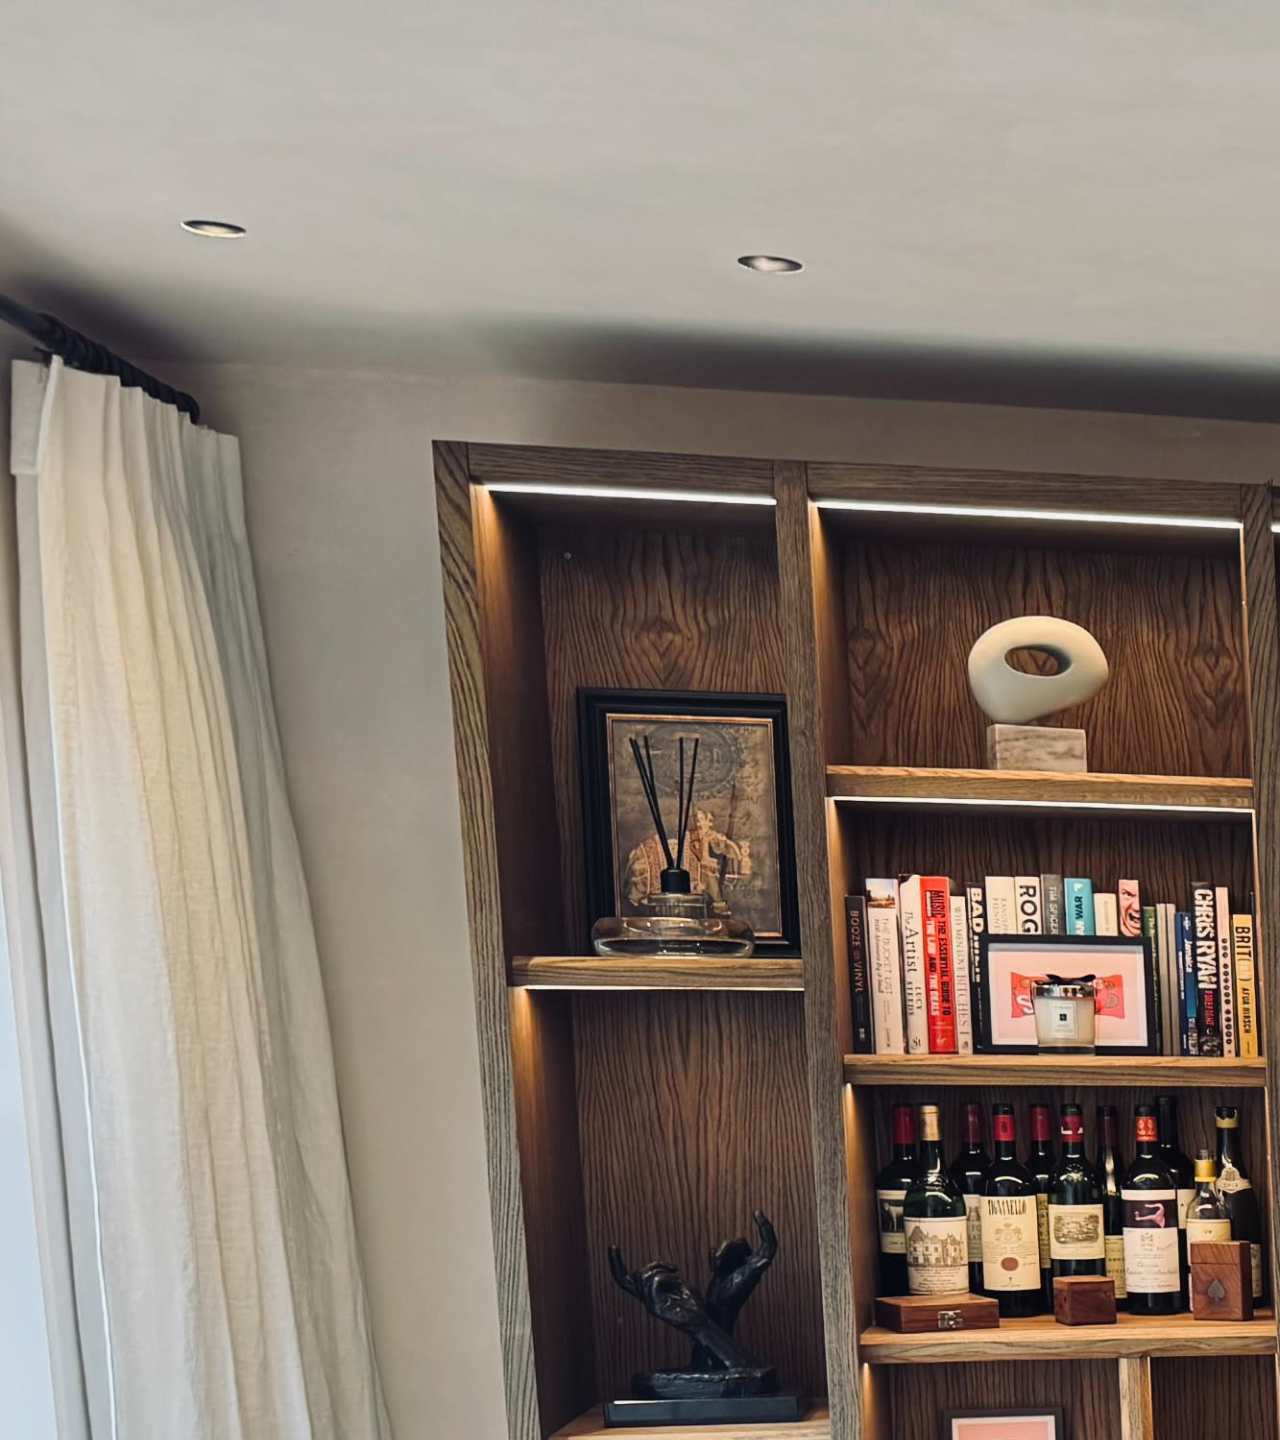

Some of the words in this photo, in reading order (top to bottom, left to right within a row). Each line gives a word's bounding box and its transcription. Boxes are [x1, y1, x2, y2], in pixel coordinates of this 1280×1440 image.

[904, 912, 914, 924] The
[930, 890, 946, 918] MUSIC
[971, 888, 983, 932] BAD
[1194, 889, 1214, 937] CHRIS
[850, 911, 860, 946] BOOZE
[905, 926, 919, 973] Artist
[1184, 939, 1193, 972] Jamaica
[1196, 941, 1217, 989] RYAN
[854, 963, 863, 992] VINYL
[956, 974, 967, 1026] BITCHES
